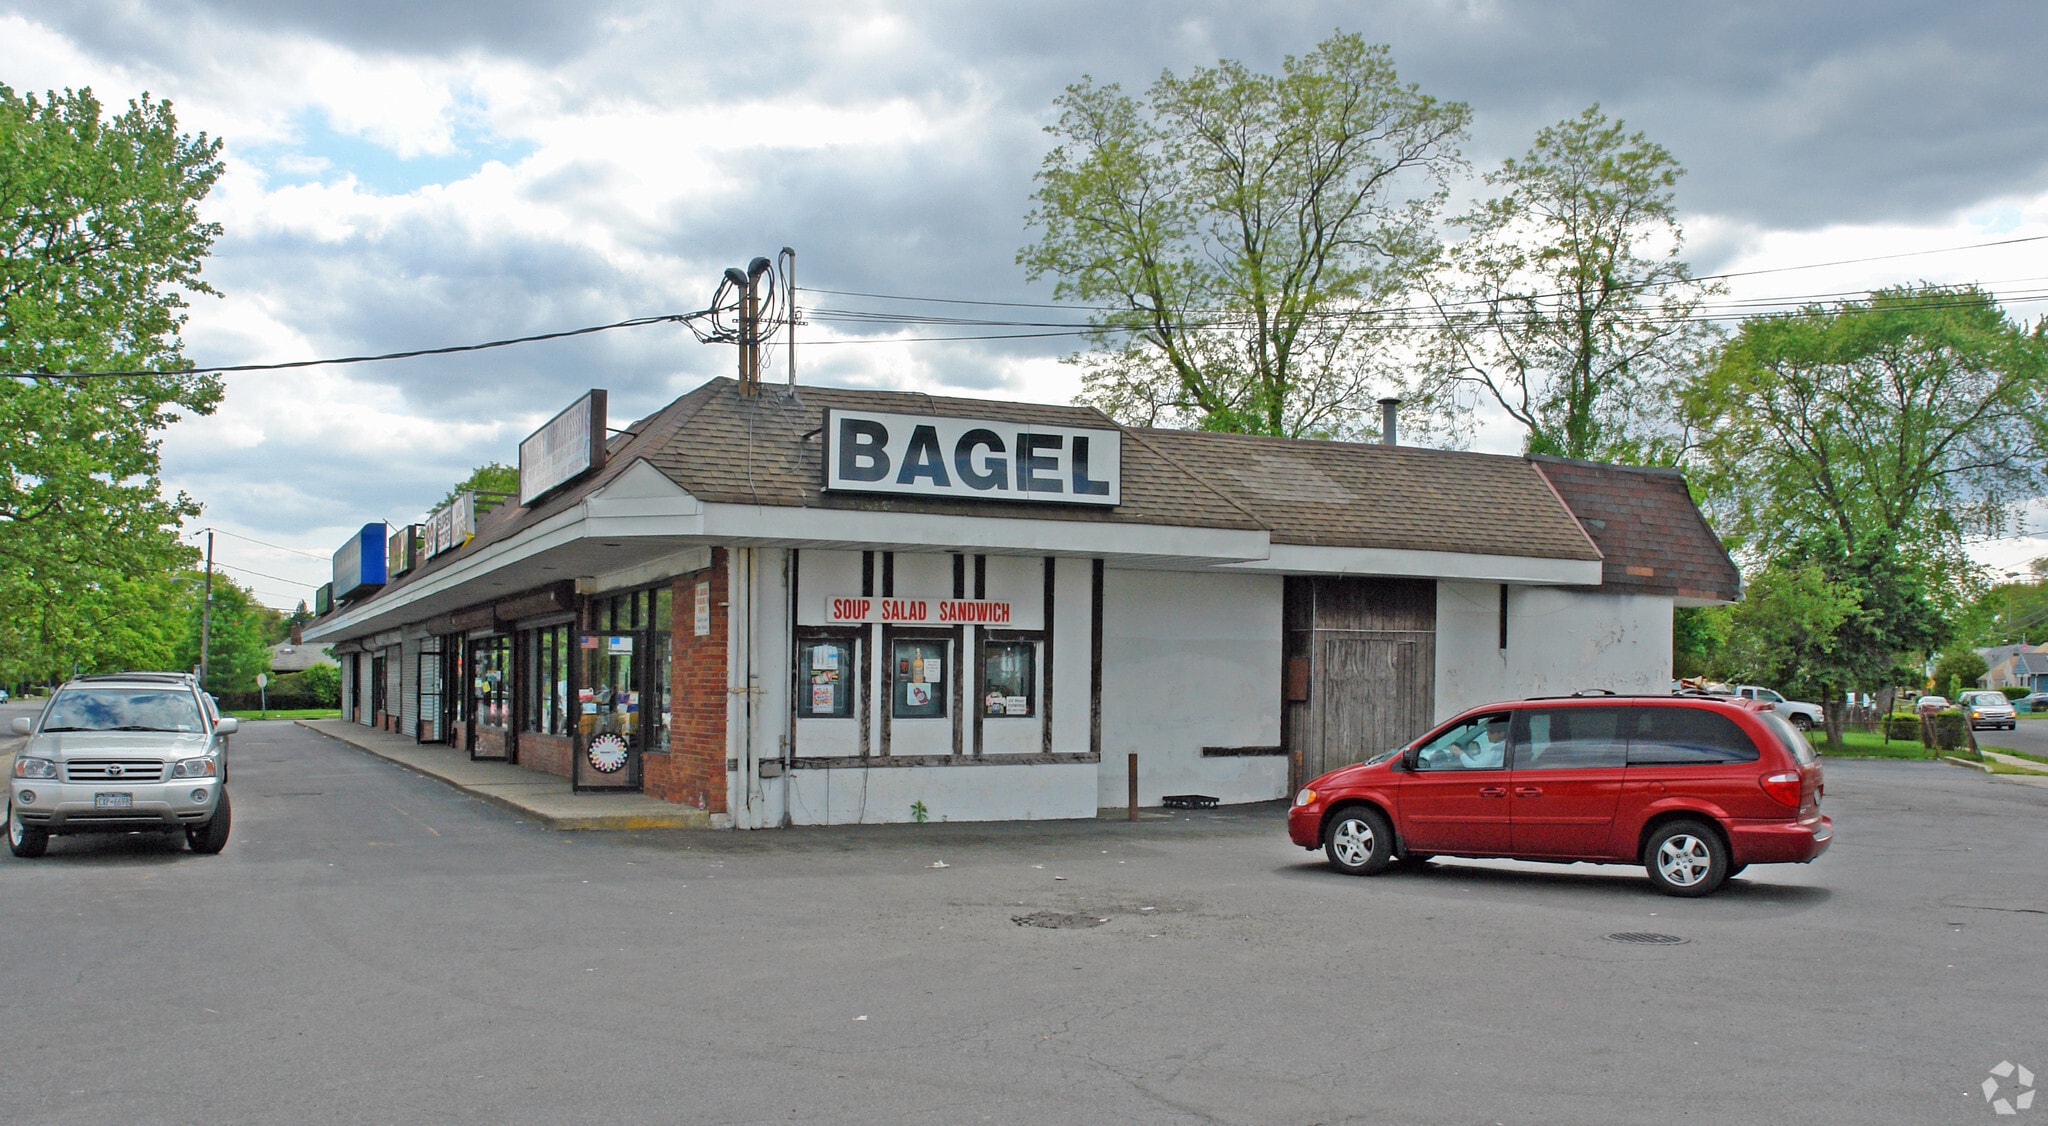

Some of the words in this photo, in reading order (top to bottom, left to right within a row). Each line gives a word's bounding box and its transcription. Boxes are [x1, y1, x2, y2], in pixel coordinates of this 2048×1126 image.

[839, 418, 1109, 496] BAGEL
[833, 599, 870, 620] SOUP
[882, 600, 927, 621] SALAD
[939, 601, 1010, 623] SANDWICH
